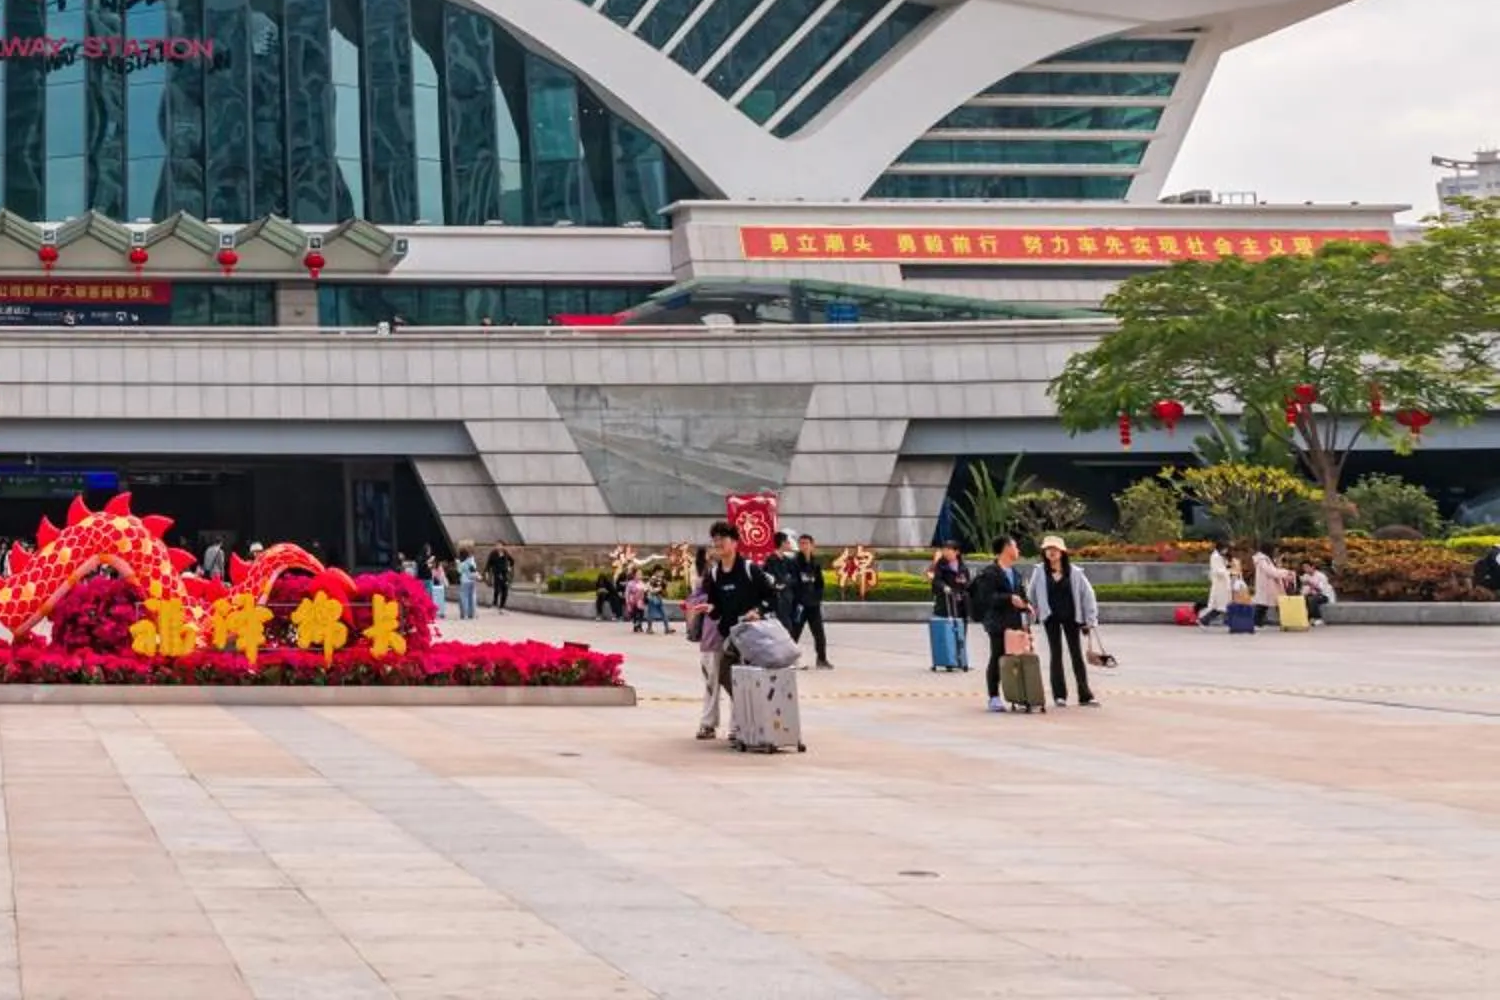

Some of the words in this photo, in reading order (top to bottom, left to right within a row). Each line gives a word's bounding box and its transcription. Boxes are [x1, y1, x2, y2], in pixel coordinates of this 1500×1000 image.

[83, 35, 215, 60] STATION
[768, 232, 874, 253] 勇立潮头
[897, 233, 999, 254] 勇毅前行
[1021, 234, 1361, 257] 努力率先实现社会主义现
